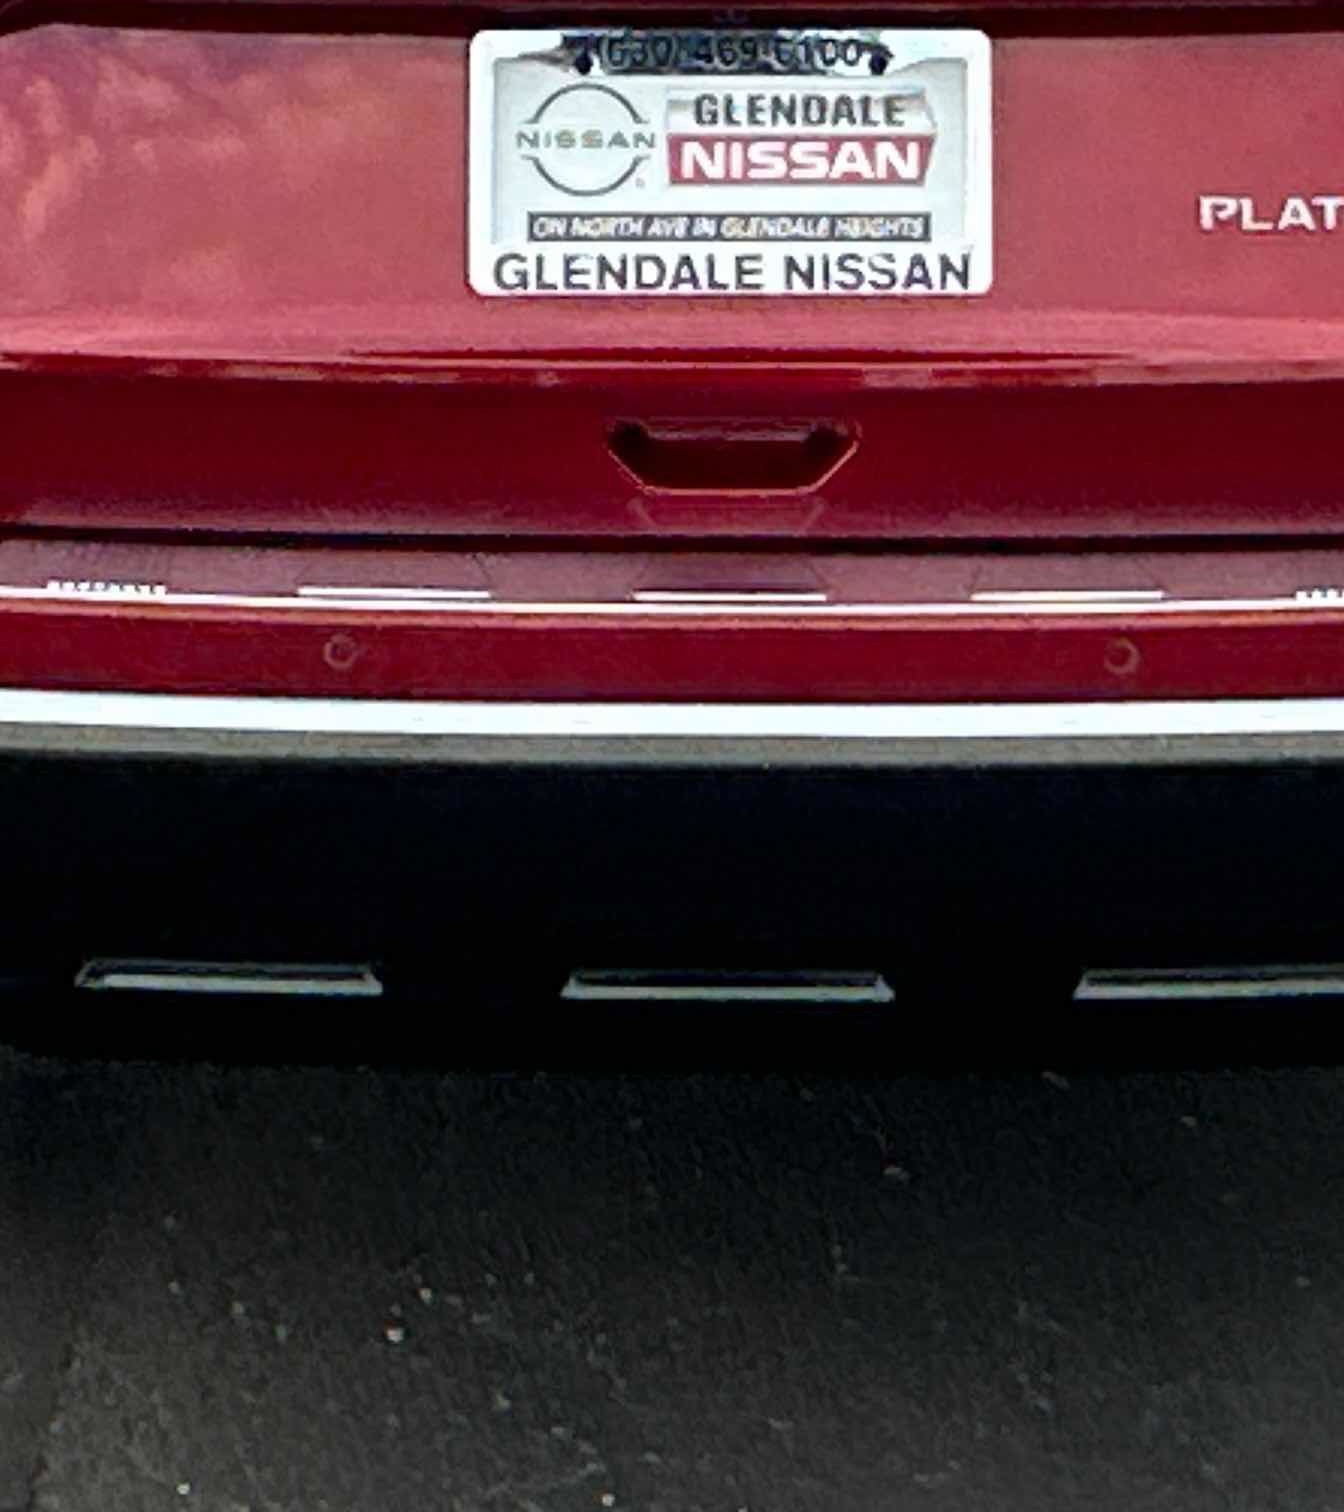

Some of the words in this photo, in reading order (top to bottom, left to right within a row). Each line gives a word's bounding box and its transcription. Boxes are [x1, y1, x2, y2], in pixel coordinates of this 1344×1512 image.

[692, 93, 906, 127] GLENDALE
[516, 130, 656, 149] NISSAN
[680, 140, 920, 180] NISSAN
[532, 217, 567, 238] ON
[720, 216, 831, 238] GLENDALE
[834, 216, 924, 238] HEIGHTS
[492, 253, 764, 291] GLENDALE
[784, 253, 971, 291] NISSAN
